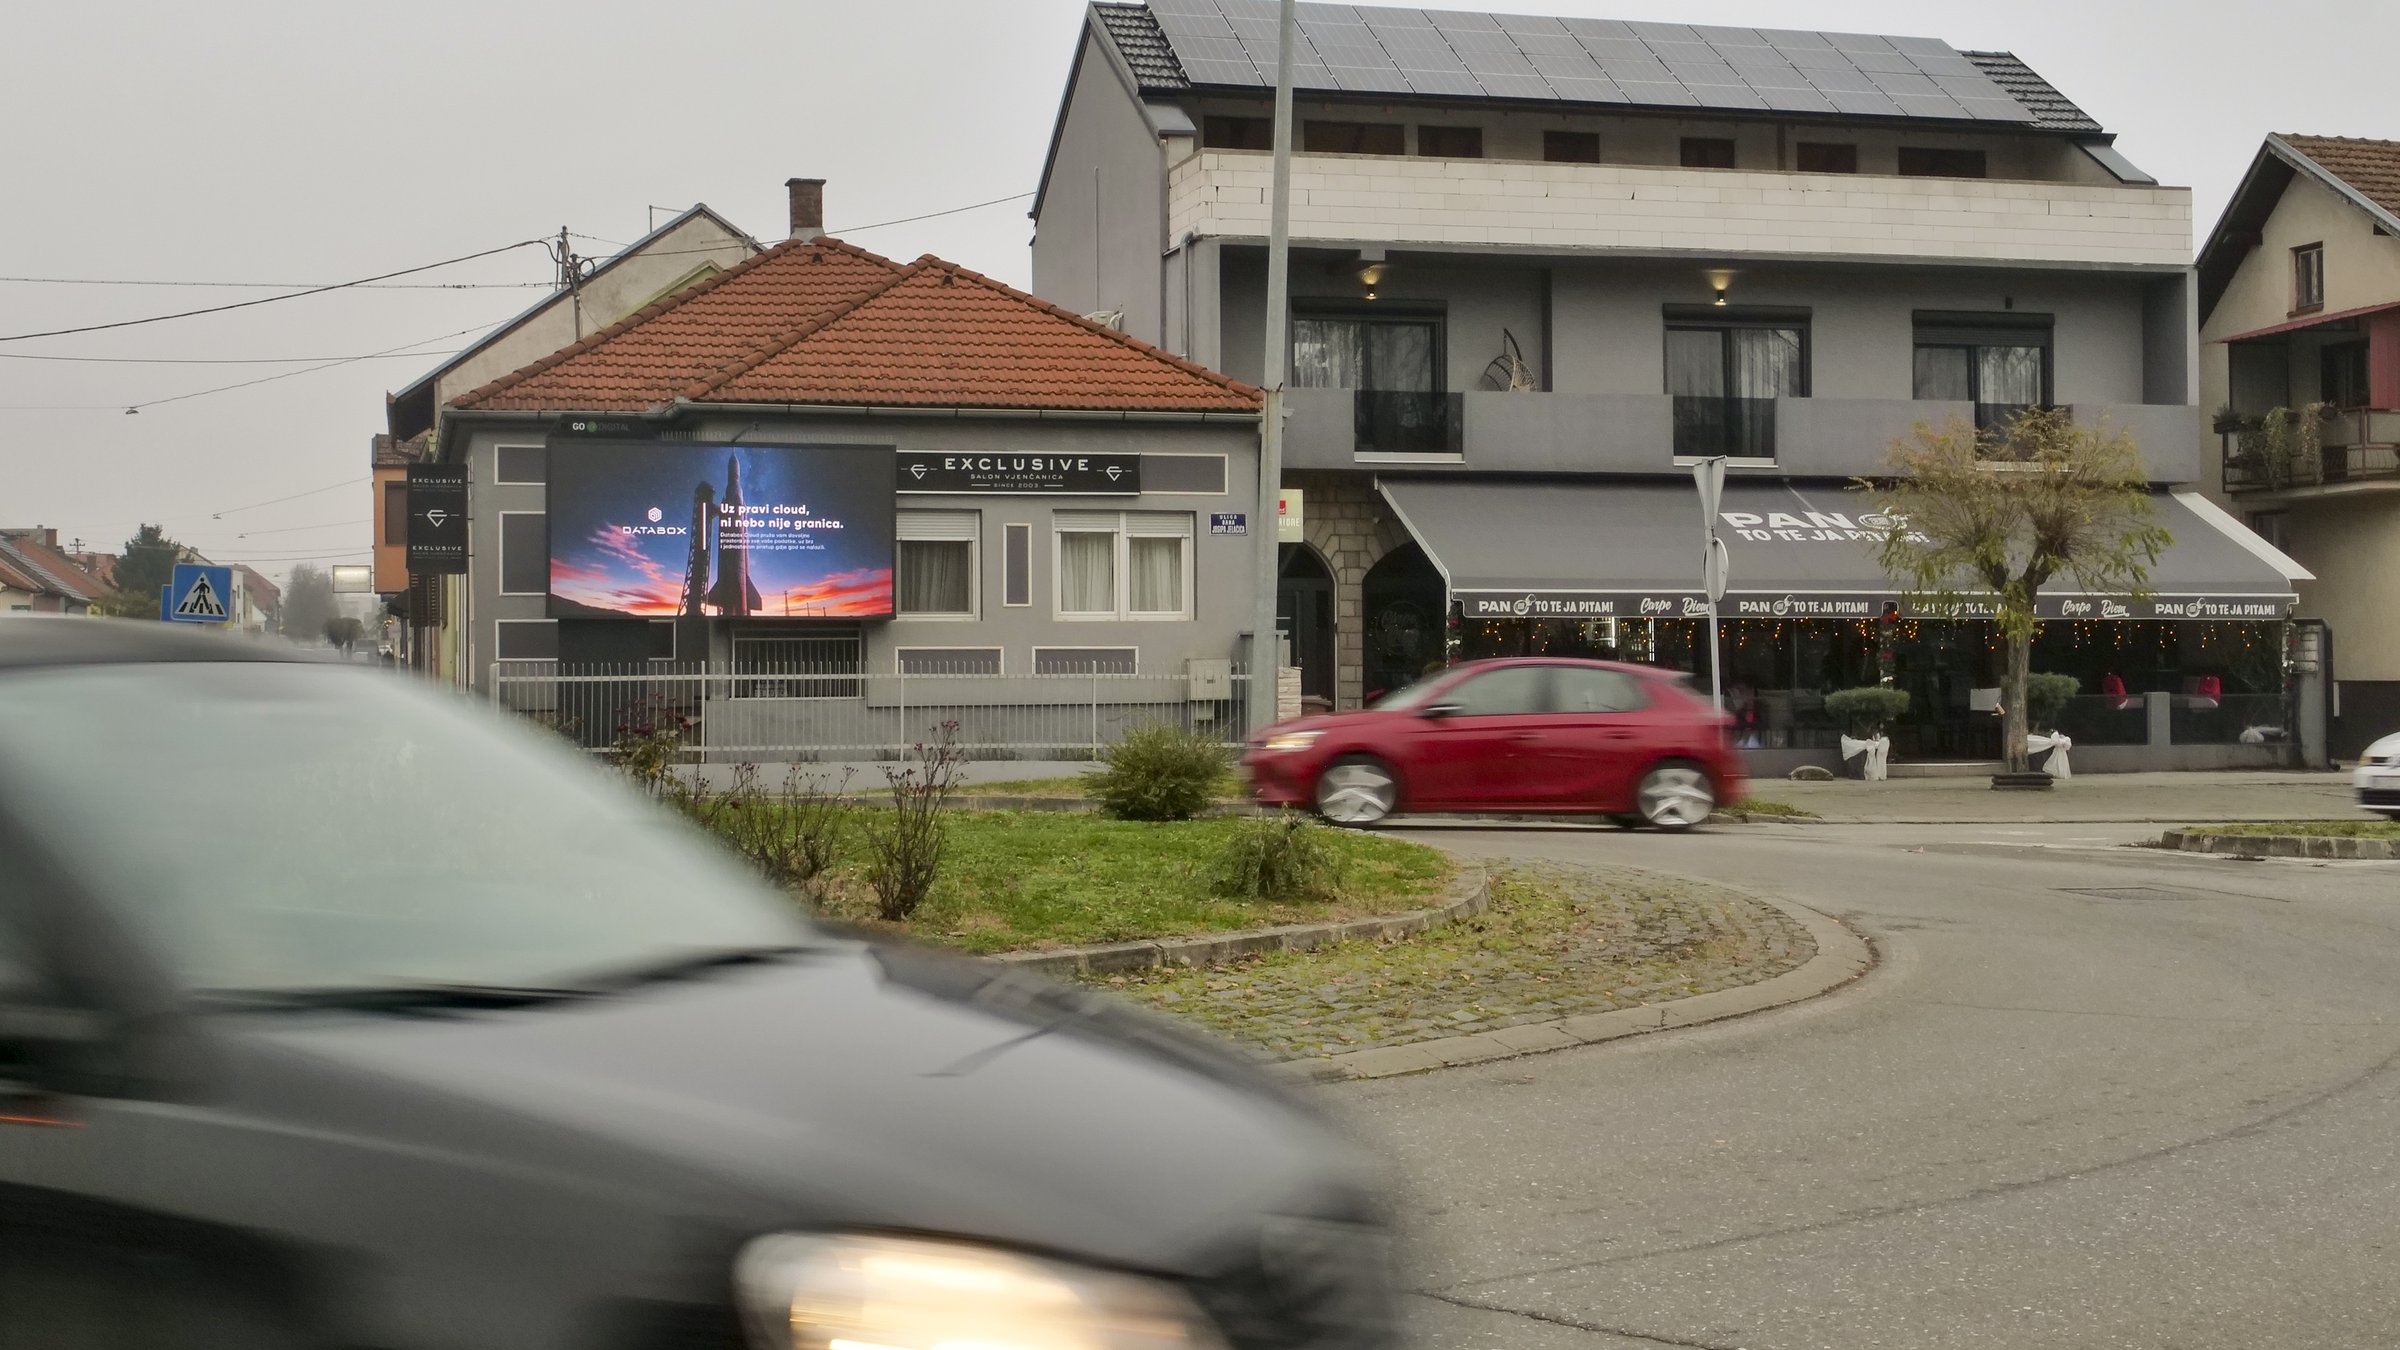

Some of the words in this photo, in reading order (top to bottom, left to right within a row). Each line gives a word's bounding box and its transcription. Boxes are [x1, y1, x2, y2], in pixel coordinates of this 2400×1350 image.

[945, 458, 1089, 471] EXCLUSIVE
[1005, 472, 1064, 480] VJENČANICA
[720, 503, 735, 514] Uz
[738, 504, 769, 516] pravi
[773, 504, 810, 516] cloud,
[720, 517, 732, 528] ni
[735, 517, 765, 528] nebo
[768, 517, 791, 530] nije
[794, 518, 844, 531] granica.
[1719, 511, 1858, 529] PAN
[622, 526, 687, 535] DATABOX
[1735, 529, 1772, 542] TO
[1773, 529, 1806, 542] TE
[1811, 529, 1844, 542] JA
[1478, 601, 1511, 612] PAN
[1535, 601, 1548, 612] TO
[1550, 601, 1562, 612] TE
[1563, 601, 1577, 613] JA
[1579, 601, 1613, 613] PITAM!
[1640, 597, 1672, 616] Carpe
[1682, 597, 1711, 617] Diem
[1739, 601, 1770, 612] PAN
[1793, 601, 1807, 612] TO
[1808, 602, 1819, 612] TE
[1820, 602, 1833, 613] JA
[1835, 602, 1869, 613] PITAM!
[2062, 599, 2091, 616] Carpe
[2101, 600, 2130, 618] Diem
[2155, 603, 2184, 615] PAN
[2205, 604, 2217, 615] TO
[2218, 604, 2229, 615] TE
[2230, 604, 2243, 615] JA
[2245, 604, 2275, 616] PITAM!
